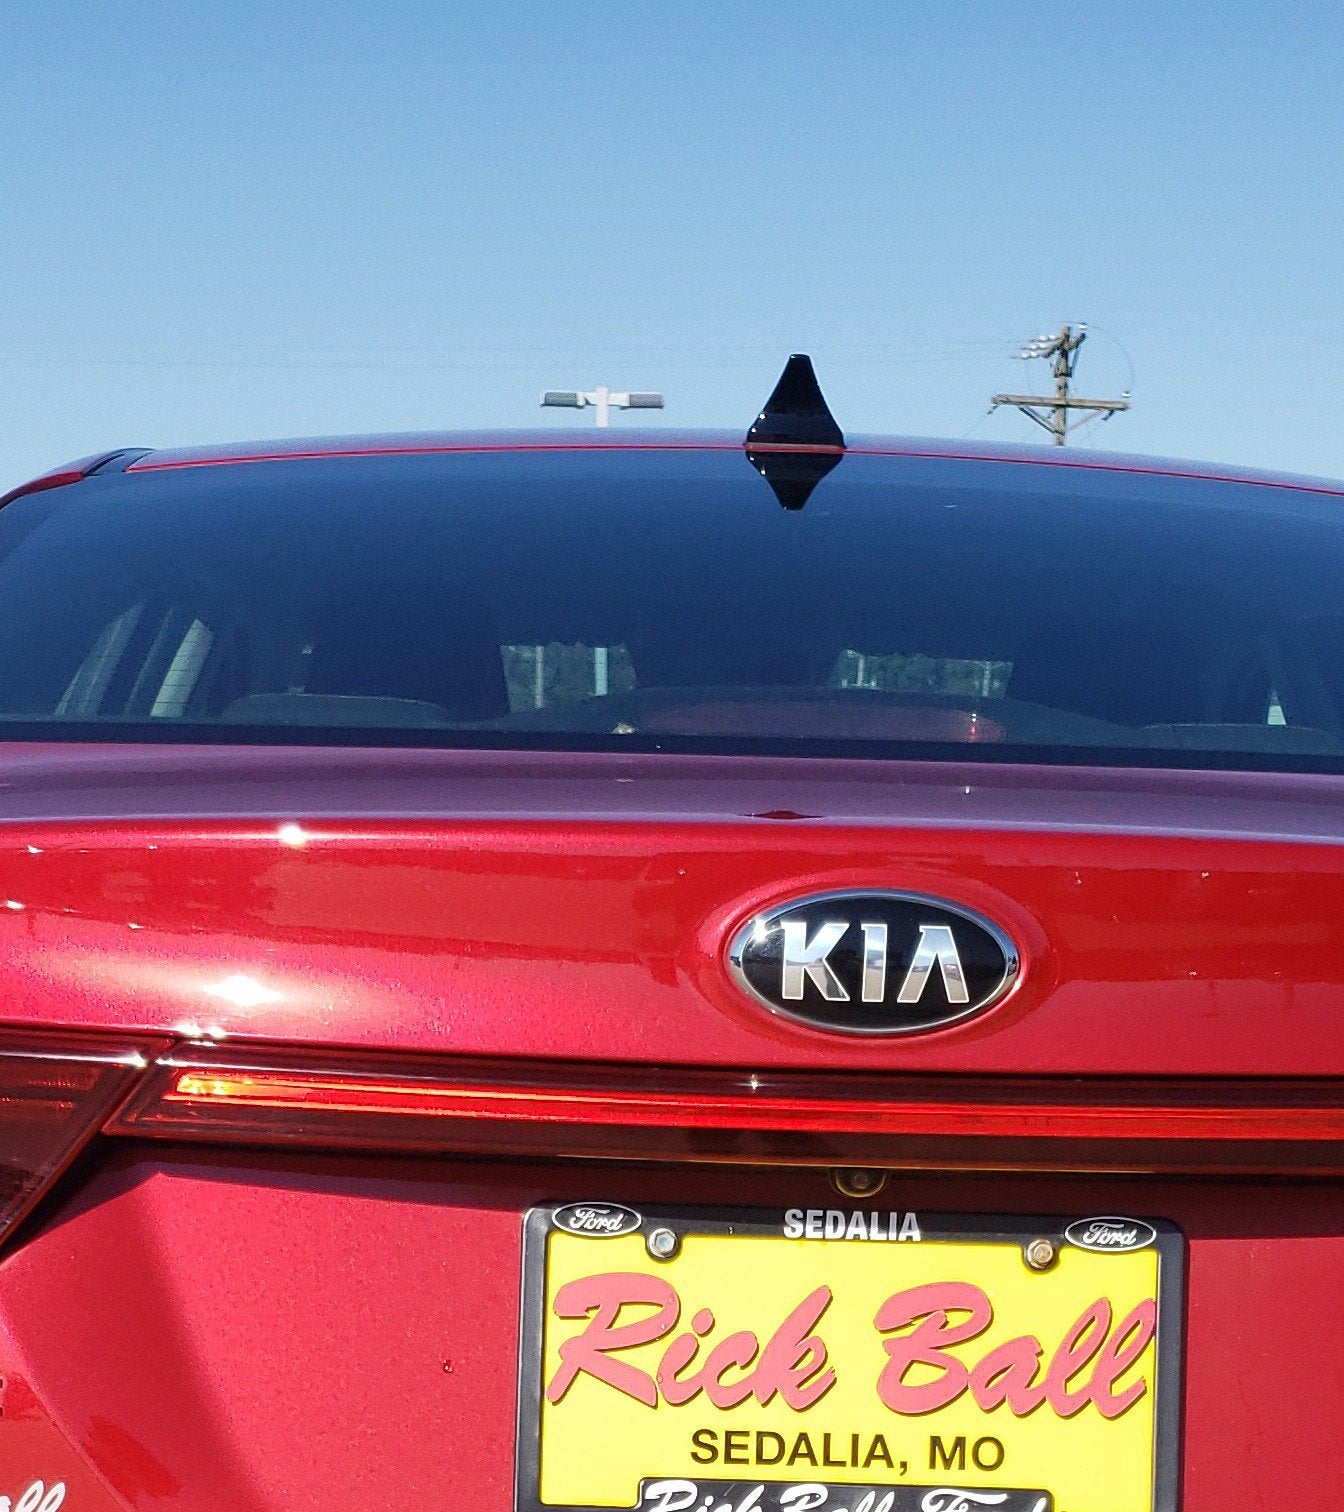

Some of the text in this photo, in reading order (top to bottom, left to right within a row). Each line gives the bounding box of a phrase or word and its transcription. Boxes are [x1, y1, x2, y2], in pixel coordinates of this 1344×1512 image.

[779, 921, 971, 1004] KIA
[569, 1207, 625, 1231] Ford
[782, 1208, 922, 1243] SEDALIA
[1082, 1222, 1138, 1245] Ford
[545, 1272, 1156, 1420] Rick Ball
[689, 1429, 1006, 1476] SEDALIA, MO
